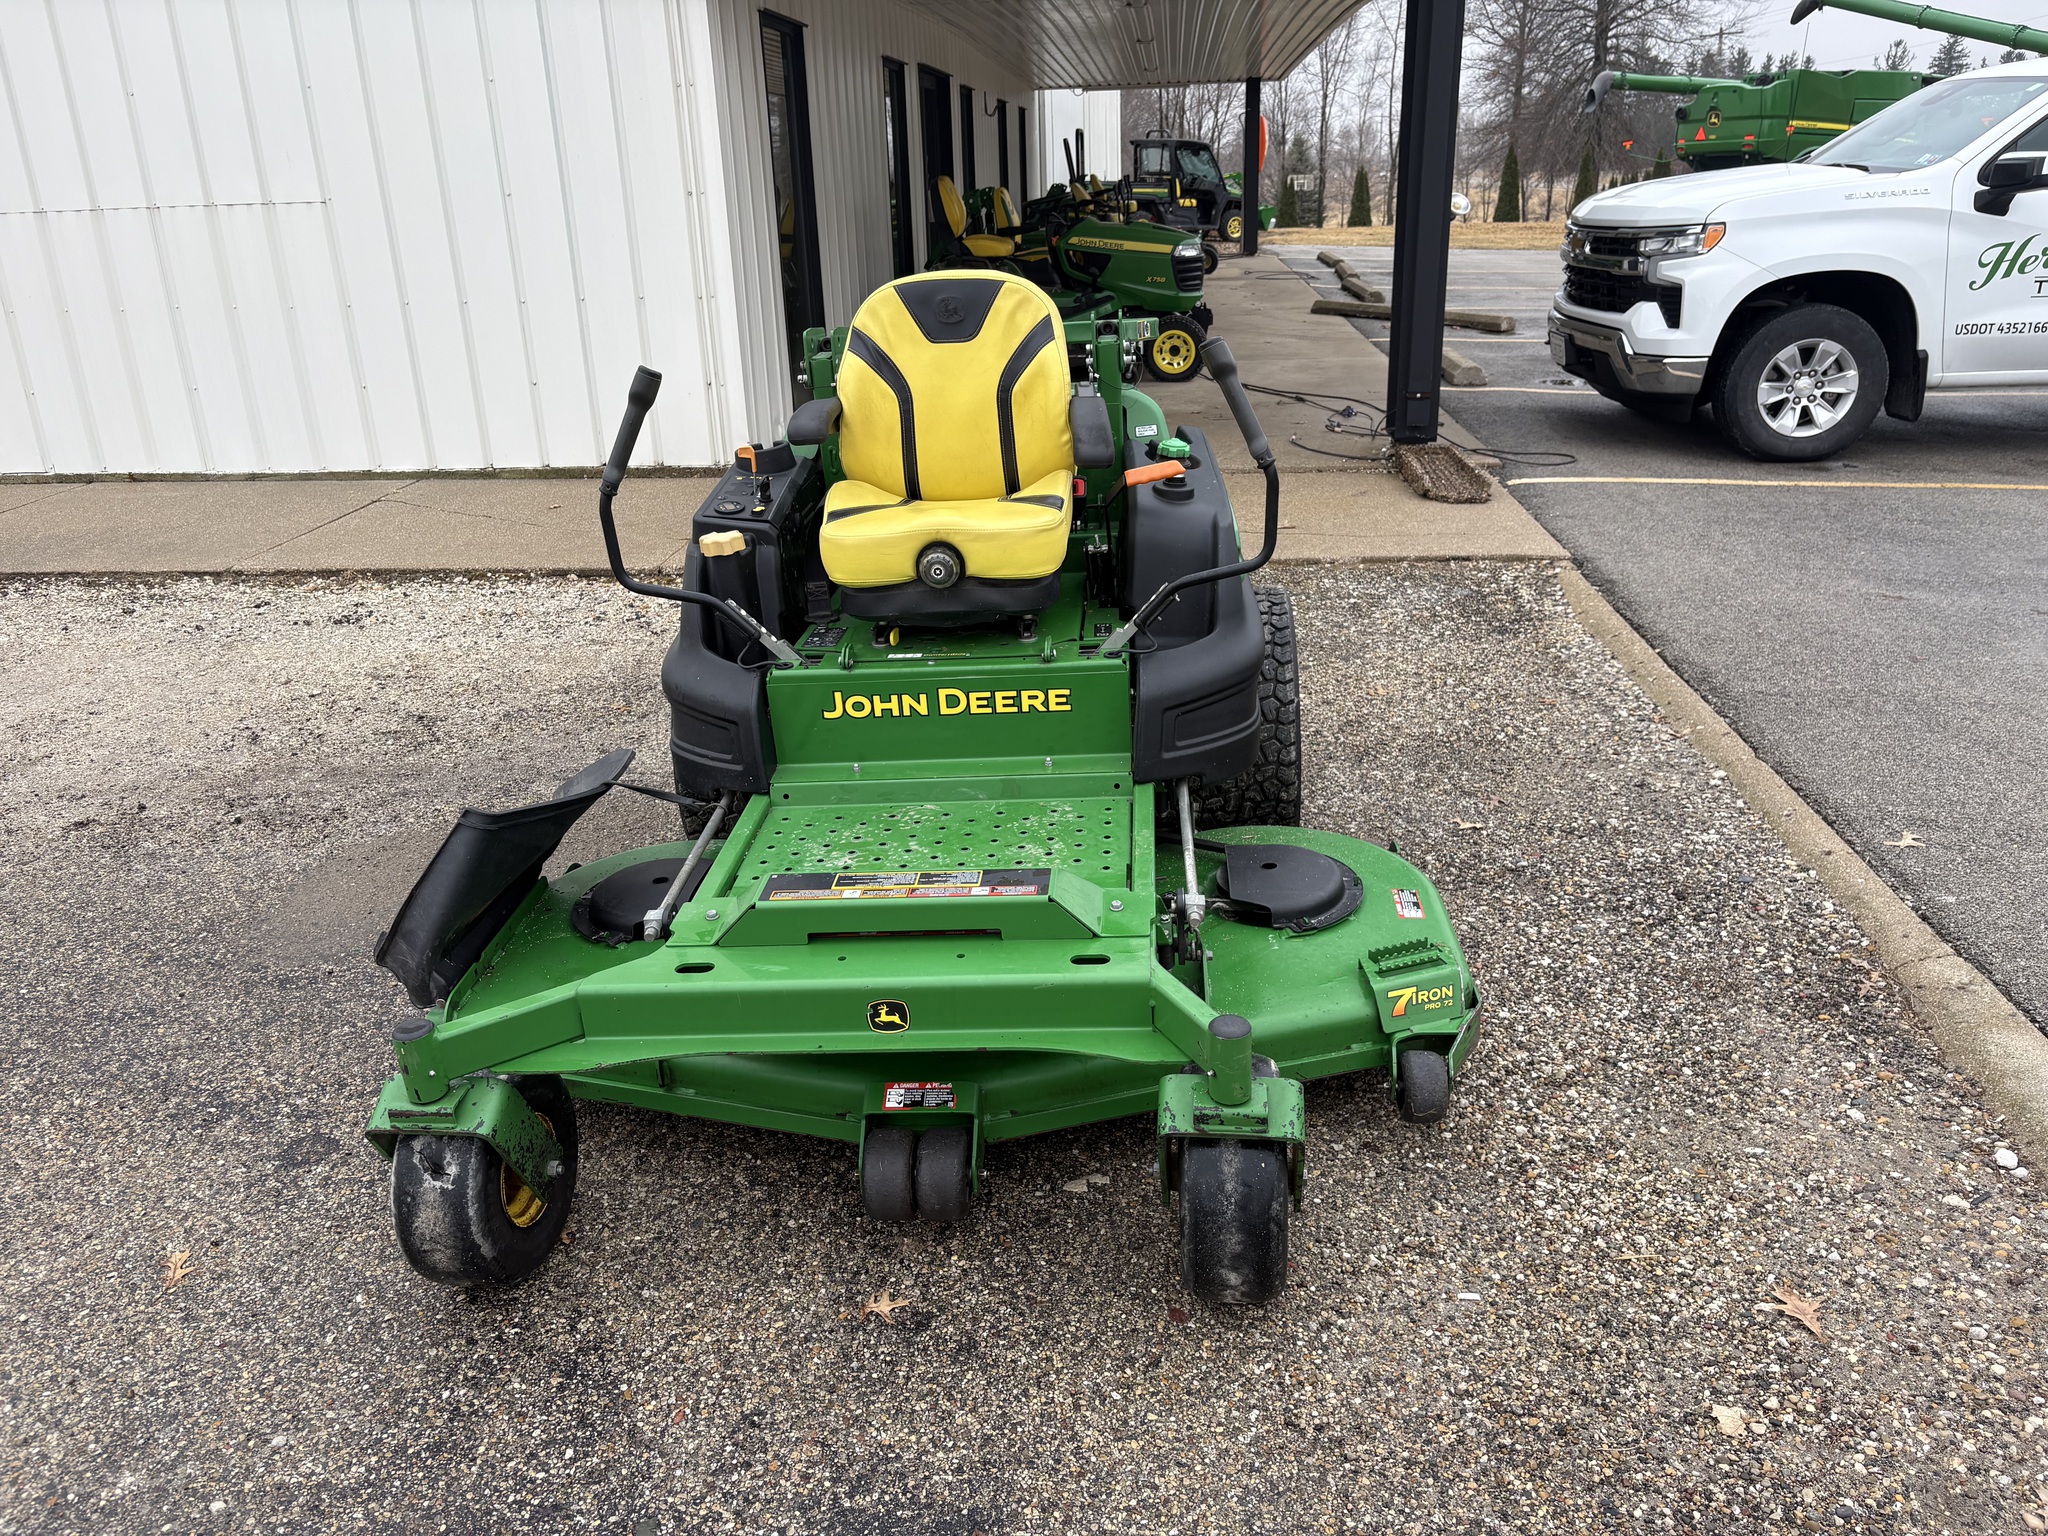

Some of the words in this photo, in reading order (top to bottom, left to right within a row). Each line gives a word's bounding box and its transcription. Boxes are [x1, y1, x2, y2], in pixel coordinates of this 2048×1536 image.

[1844, 188, 1931, 201] SILVERADO
[1076, 238, 1097, 247] JOHN
[1098, 240, 1125, 250] DEERE
[1955, 322, 1996, 336] USDOT
[1997, 321, 2048, 335] 4352166
[822, 690, 929, 720] JOHN
[937, 687, 1072, 717] DEERE
[1424, 1001, 1441, 1011] PRO
[1443, 999, 1454, 1007] 72
